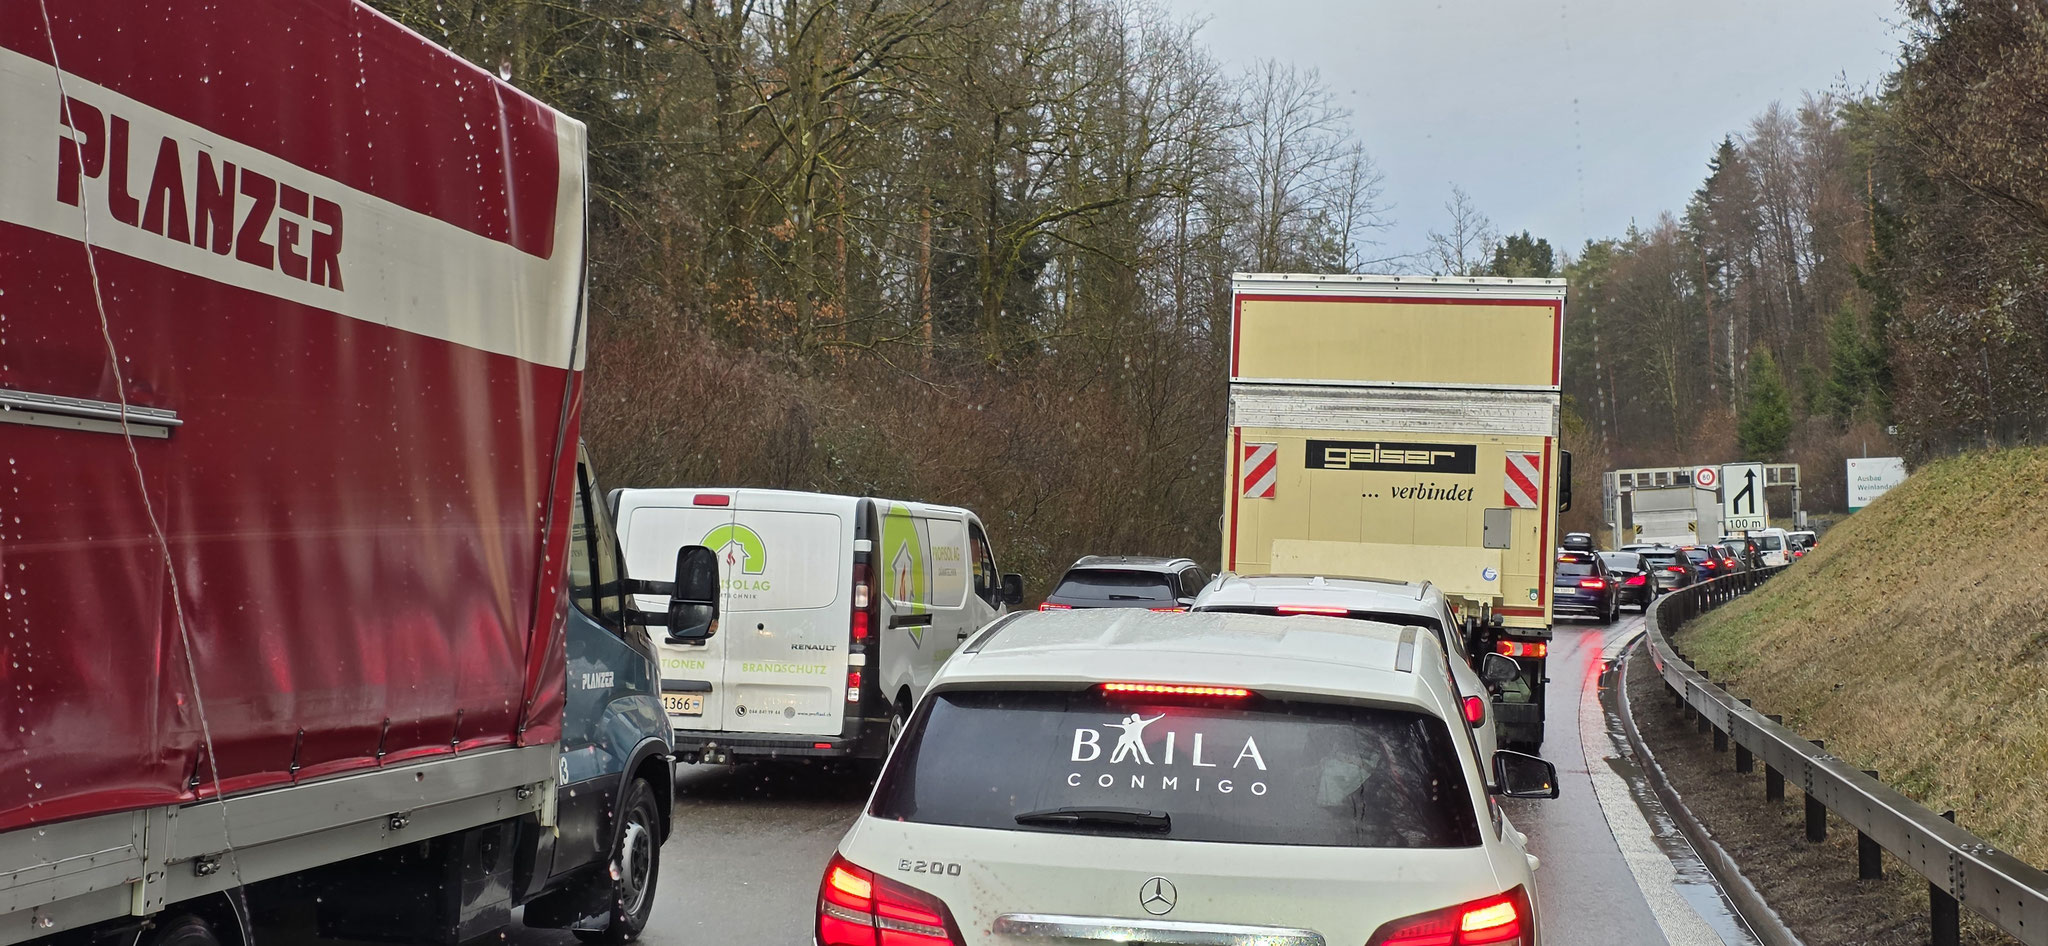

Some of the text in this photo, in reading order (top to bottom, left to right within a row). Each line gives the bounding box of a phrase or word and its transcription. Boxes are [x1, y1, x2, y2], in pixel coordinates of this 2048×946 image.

[57, 94, 345, 292] PLANZER
[1324, 443, 1456, 469] gaiser
[1391, 482, 1474, 502] verbindet
[1729, 519, 1761, 529] 100 m
[752, 580, 771, 591] AG
[791, 643, 836, 651] RENAULT
[661, 658, 705, 669] TIONEN
[742, 662, 827, 675] BRANDSCHUTZ
[582, 671, 615, 690] PLANZER
[664, 697, 690, 710] 1366
[1067, 772, 1267, 796] CONMIGO
[898, 858, 962, 877] B200
